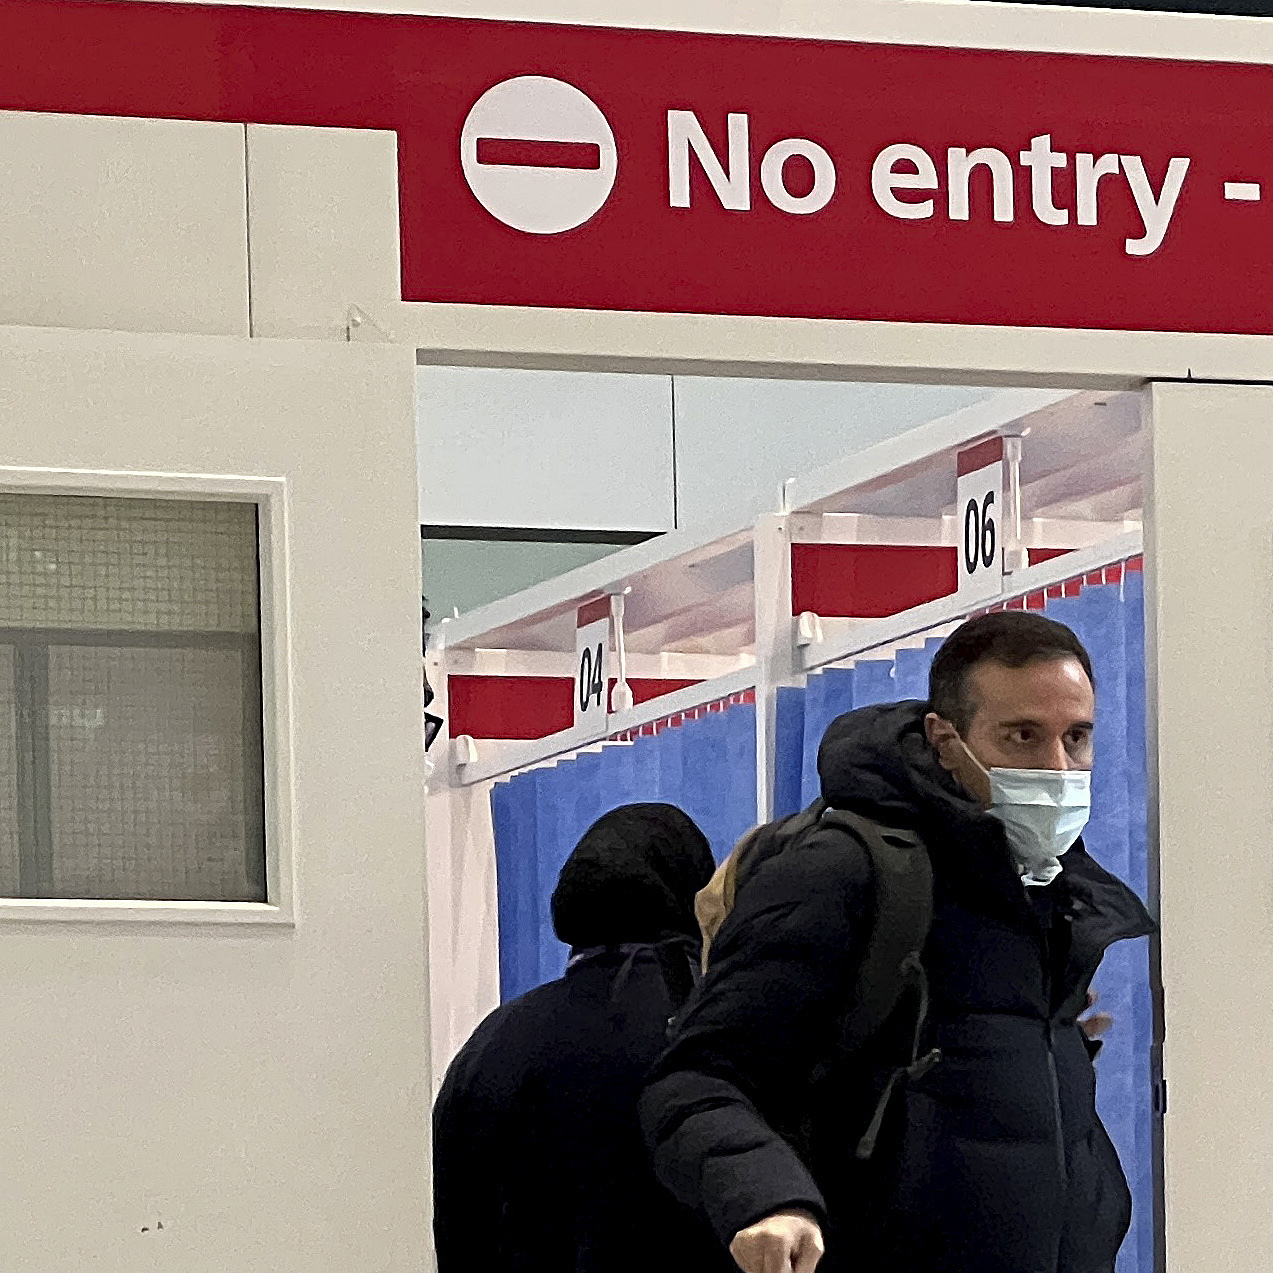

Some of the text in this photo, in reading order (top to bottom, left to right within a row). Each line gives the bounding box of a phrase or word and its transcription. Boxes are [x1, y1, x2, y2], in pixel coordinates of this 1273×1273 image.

[668, 110, 836, 214] No
[872, 134, 1190, 255] entry
[964, 490, 996, 575] 06
[580, 643, 603, 712] 04
